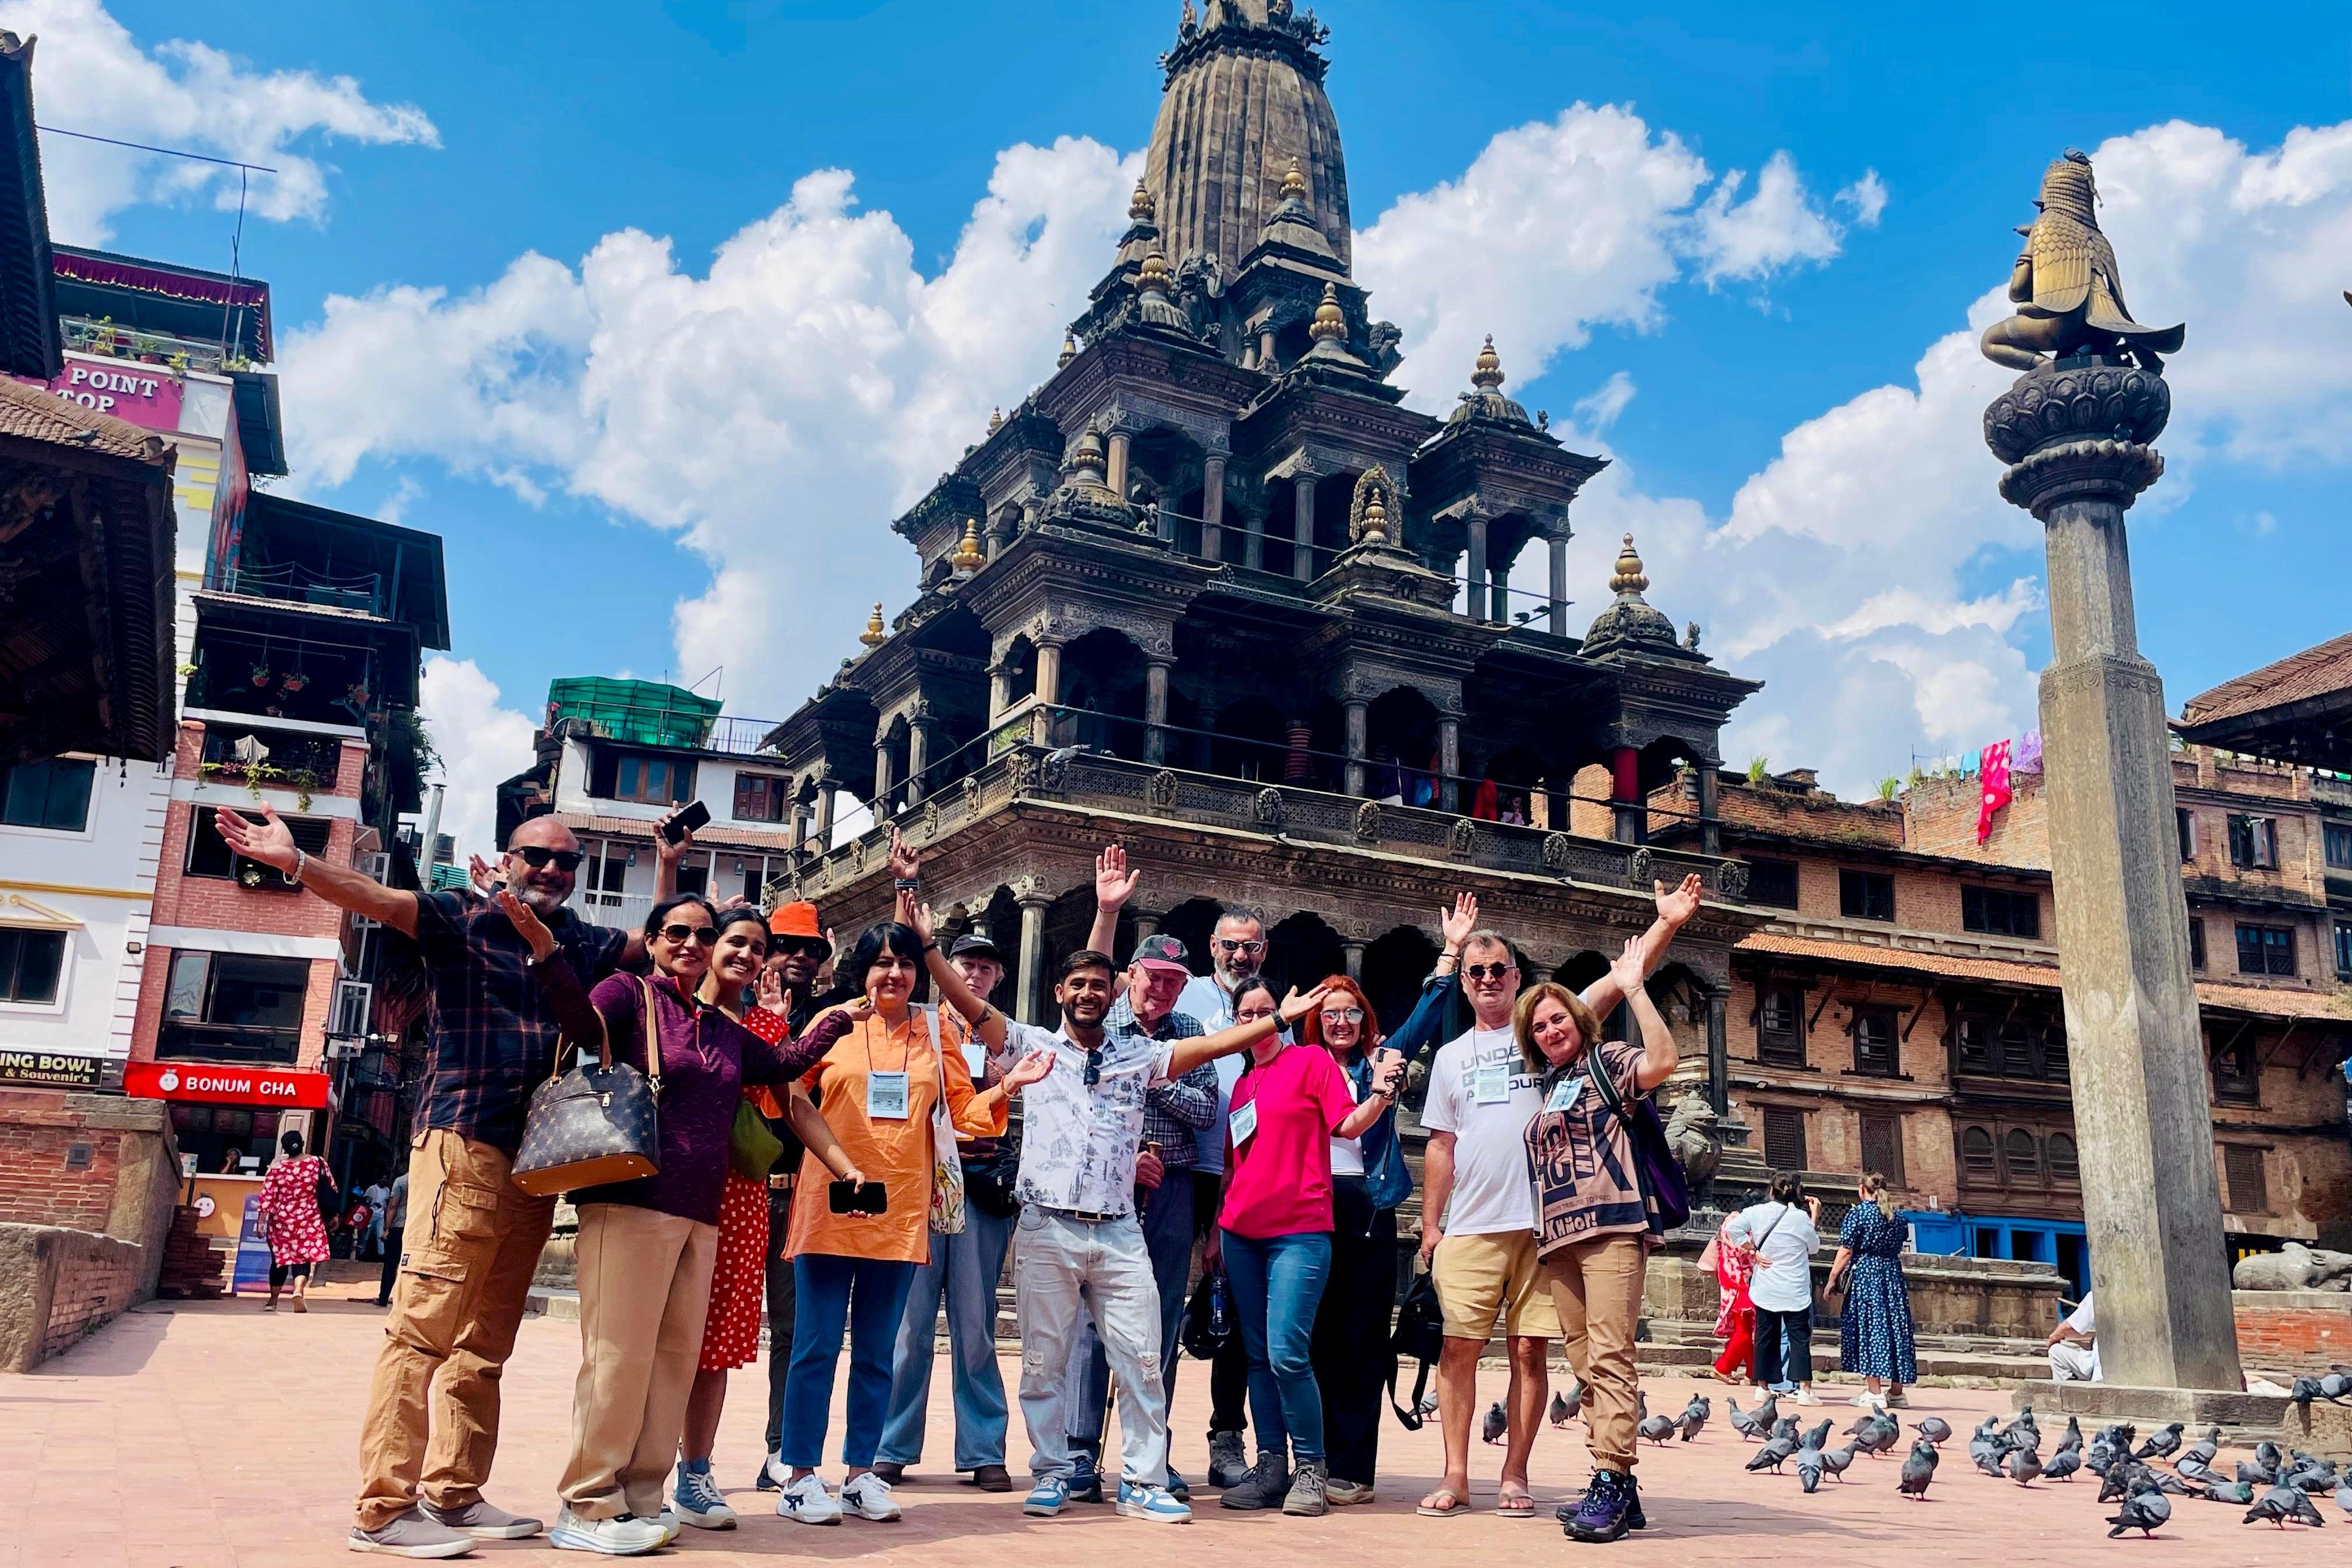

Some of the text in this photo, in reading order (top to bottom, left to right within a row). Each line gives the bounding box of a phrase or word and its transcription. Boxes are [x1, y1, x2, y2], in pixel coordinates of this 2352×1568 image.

[70, 368, 158, 397] POINT
[38, 1055, 95, 1073] BOWL
[1461, 1045, 1521, 1070] UNDE
[5, 1068, 90, 1083] & Souvenir's
[186, 1077, 296, 1096] BONUM CHA
[1466, 1077, 1545, 1102] AOUR
